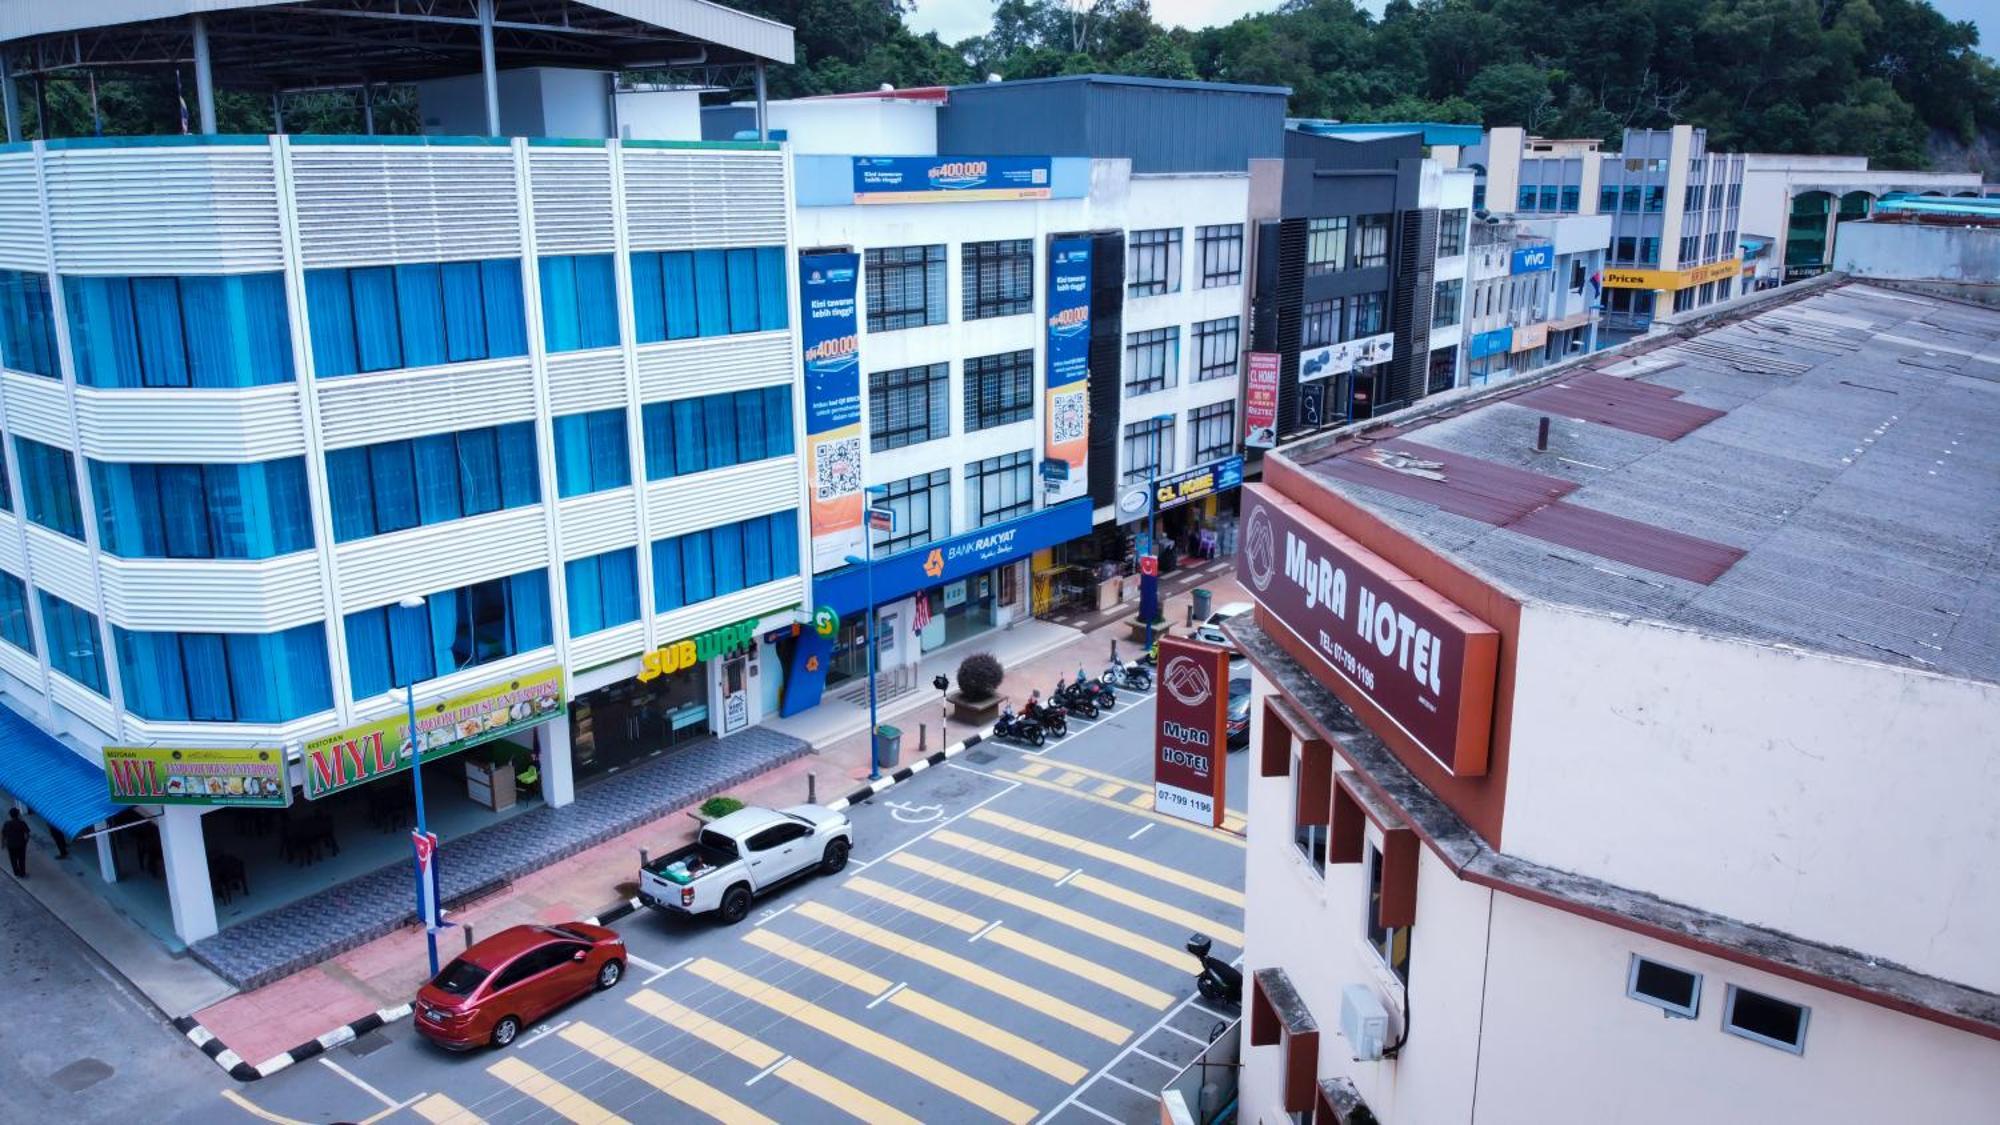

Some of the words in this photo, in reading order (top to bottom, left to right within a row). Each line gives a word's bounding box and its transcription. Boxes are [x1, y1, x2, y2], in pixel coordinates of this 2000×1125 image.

[1524, 250, 1545, 267] vivo
[1608, 273, 1645, 284] Prices
[811, 300, 826, 309] Kini
[812, 309, 831, 318] lebih
[1250, 370, 1257, 383] CL
[1258, 371, 1276, 384] HOME
[1157, 486, 1177, 503] CL
[1179, 473, 1214, 496] HOME
[1285, 531, 1347, 620] MyRA
[1357, 586, 1442, 696] HOTEL
[637, 618, 760, 684] SUBWAY
[1334, 641, 1356, 675] 07-799
[1357, 663, 1375, 691] 1196
[307, 734, 344, 750] RESTORAN
[1164, 720, 1209, 746] MyRA
[311, 730, 397, 794] MYL
[1163, 747, 1209, 772] HOTEL
[110, 758, 167, 797] MYL
[1158, 789, 1188, 807] 07-799
[1190, 798, 1212, 814] 1196
